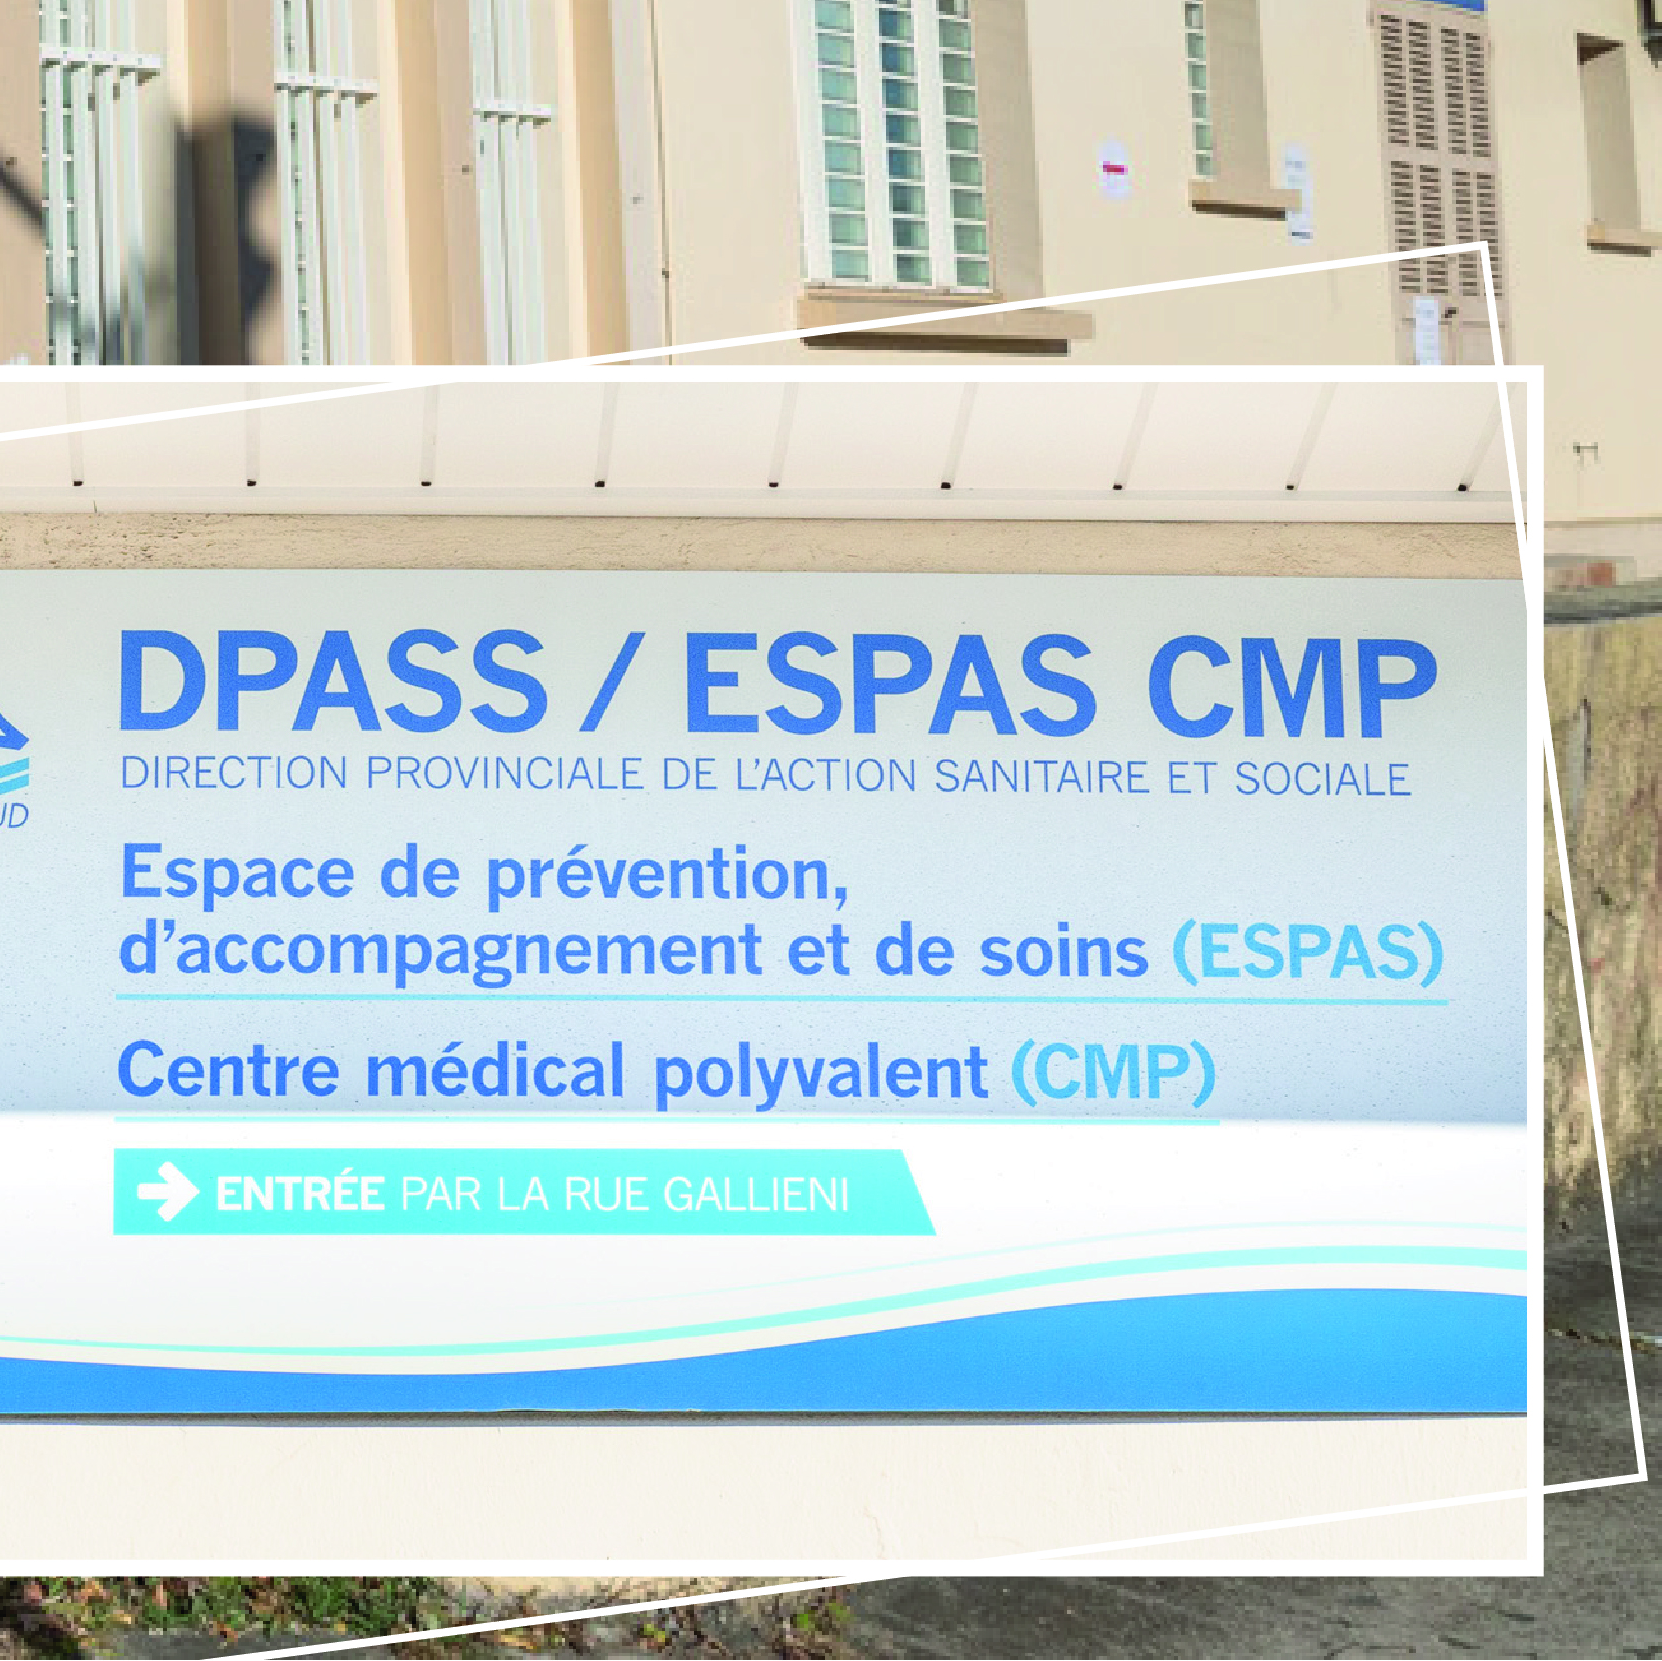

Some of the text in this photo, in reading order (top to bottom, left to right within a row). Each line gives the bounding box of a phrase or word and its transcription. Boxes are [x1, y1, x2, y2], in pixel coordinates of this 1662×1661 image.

[120, 628, 1438, 739] DPASS / ESPAS CMP
[122, 755, 346, 790] DIRECTION
[367, 756, 645, 790] PROVINCIALE
[663, 757, 719, 791] DE
[935, 758, 1150, 794] SANITAIRE
[1168, 760, 1219, 795] ET
[1235, 761, 1413, 797] SOCIALE
[122, 842, 848, 912] Espace de prévention,
[788, 923, 851, 978] et
[875, 920, 955, 978] de
[979, 921, 1149, 979] soins
[1172, 918, 1445, 990] (ESPAS)
[117, 1038, 1216, 1113] Centre médical polyvalent (CMP)
[215, 1166, 849, 1213] ENTRÉE PAR LA RUE GALLIENI
